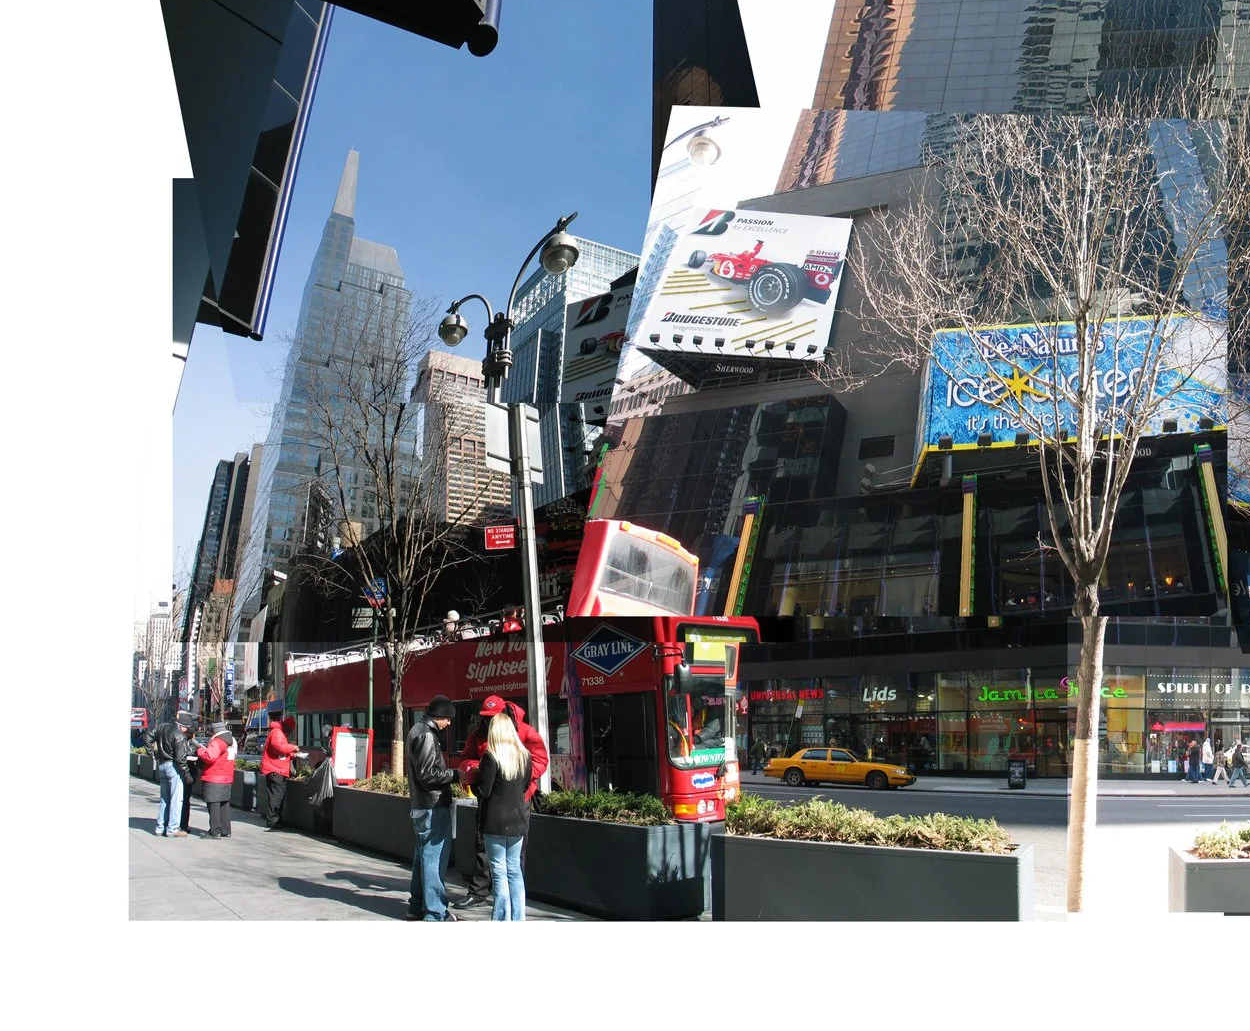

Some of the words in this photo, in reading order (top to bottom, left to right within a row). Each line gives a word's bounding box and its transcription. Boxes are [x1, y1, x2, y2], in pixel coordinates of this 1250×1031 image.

[737, 218, 774, 226] PASSION
[743, 226, 789, 234] EXCELLENCE
[804, 263, 826, 272] AMD
[660, 312, 741, 327] BRIDGESTONE
[715, 363, 754, 374] SHERWOOD
[967, 415, 987, 431] it's
[994, 413, 1021, 429] the
[584, 644, 609, 659] GRAY
[611, 641, 635, 654] LINE
[582, 676, 604, 686] 71338
[863, 686, 897, 702] Lids
[1157, 682, 1209, 694] SPIRIT
[1215, 683, 1234, 694] OF
[750, 689, 798, 701] UNIVERSAL
[799, 688, 824, 699] NEWS
